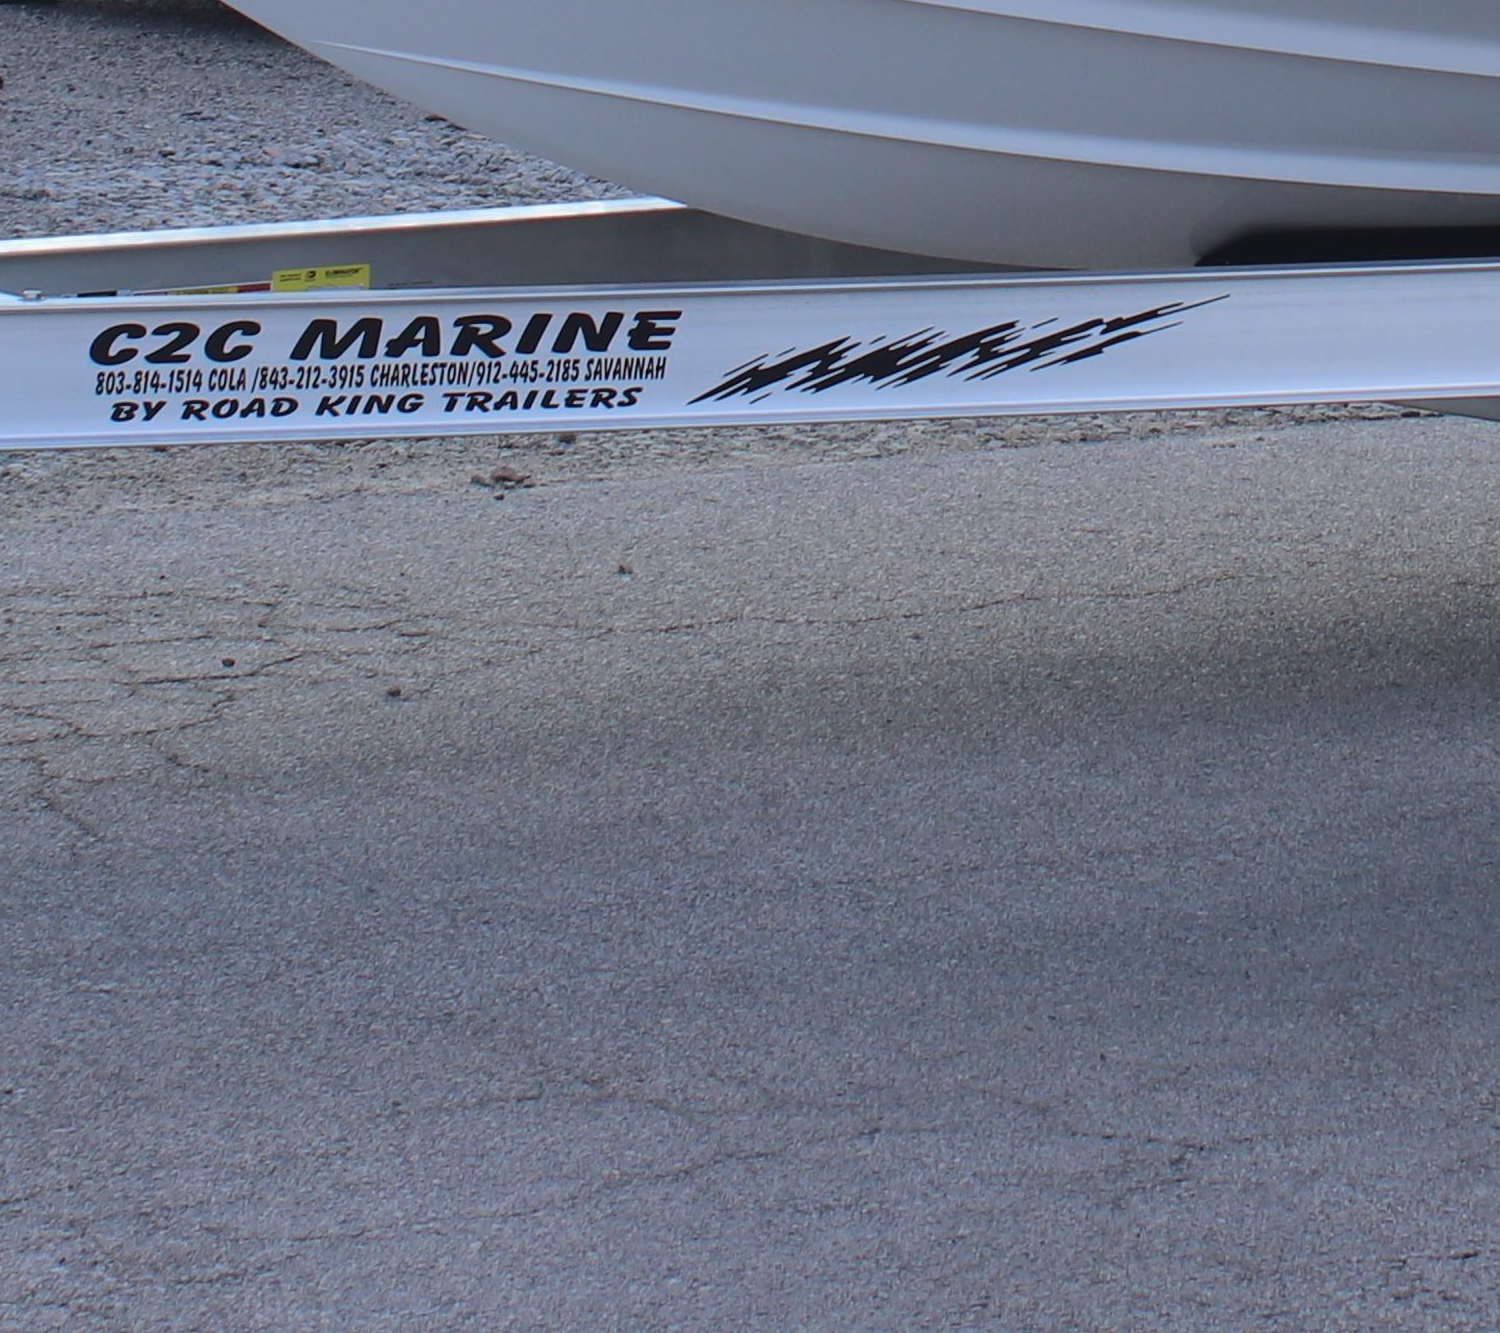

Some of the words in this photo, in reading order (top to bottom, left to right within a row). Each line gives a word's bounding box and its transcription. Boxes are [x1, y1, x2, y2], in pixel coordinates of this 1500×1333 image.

[88, 320, 262, 367] C2C
[288, 309, 684, 361] MARINE
[95, 367, 203, 396] 803-814-1514
[207, 366, 247, 393] COLA
[250, 364, 366, 395] /843-212-3915
[370, 357, 581, 389] CHARLESTON/912-445-2185
[584, 355, 668, 383] SAVANNAH
[109, 400, 168, 423] BY
[179, 395, 300, 421] ROAD
[315, 392, 425, 417] KING
[441, 385, 645, 414] TRAILERS
